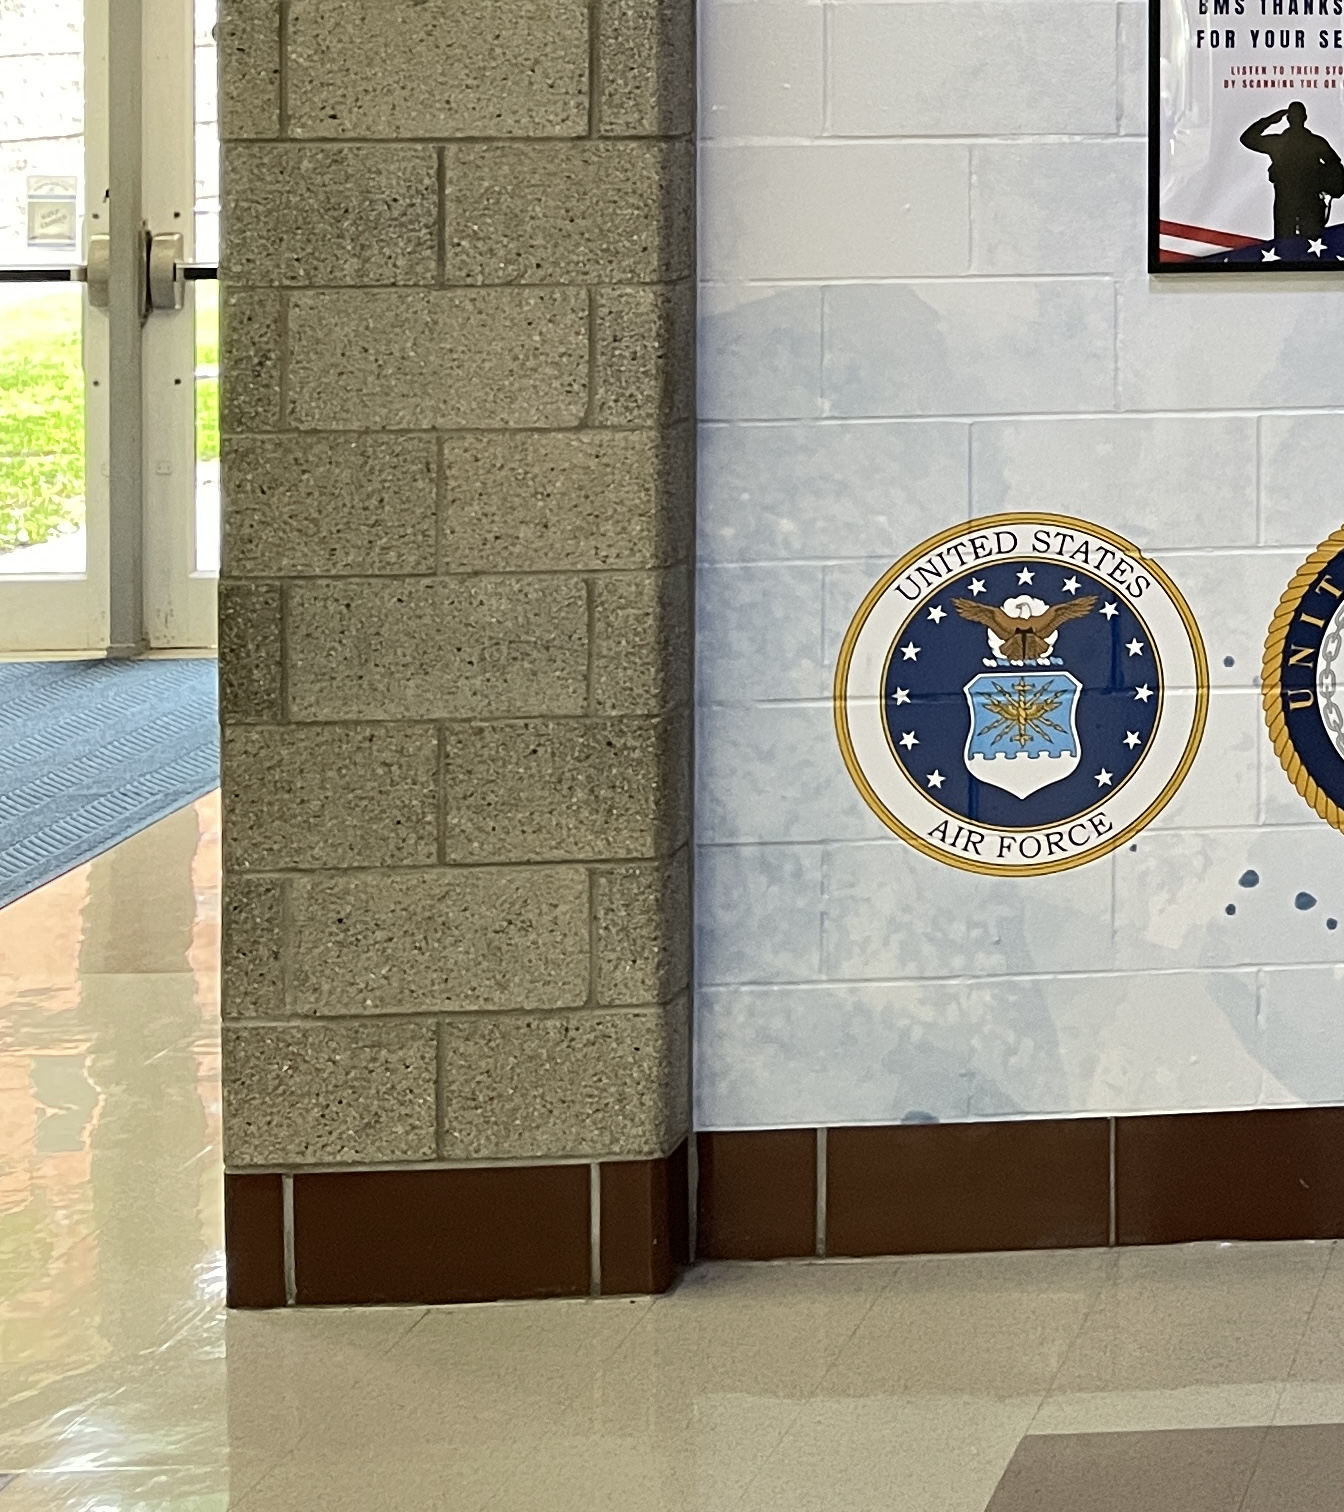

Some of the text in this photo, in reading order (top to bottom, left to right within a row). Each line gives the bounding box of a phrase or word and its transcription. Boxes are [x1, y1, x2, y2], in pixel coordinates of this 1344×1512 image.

[1197, 30, 1235, 48] FOR
[1250, 30, 1304, 48] YOUR
[1231, 66, 1267, 75] LISTEN
[1273, 66, 1284, 75] TO
[1291, 66, 1319, 75] THEIR
[1224, 79, 1235, 88] BY
[894, 529, 1151, 600] UNITED STATES
[928, 812, 1114, 858] AIR FORCE
